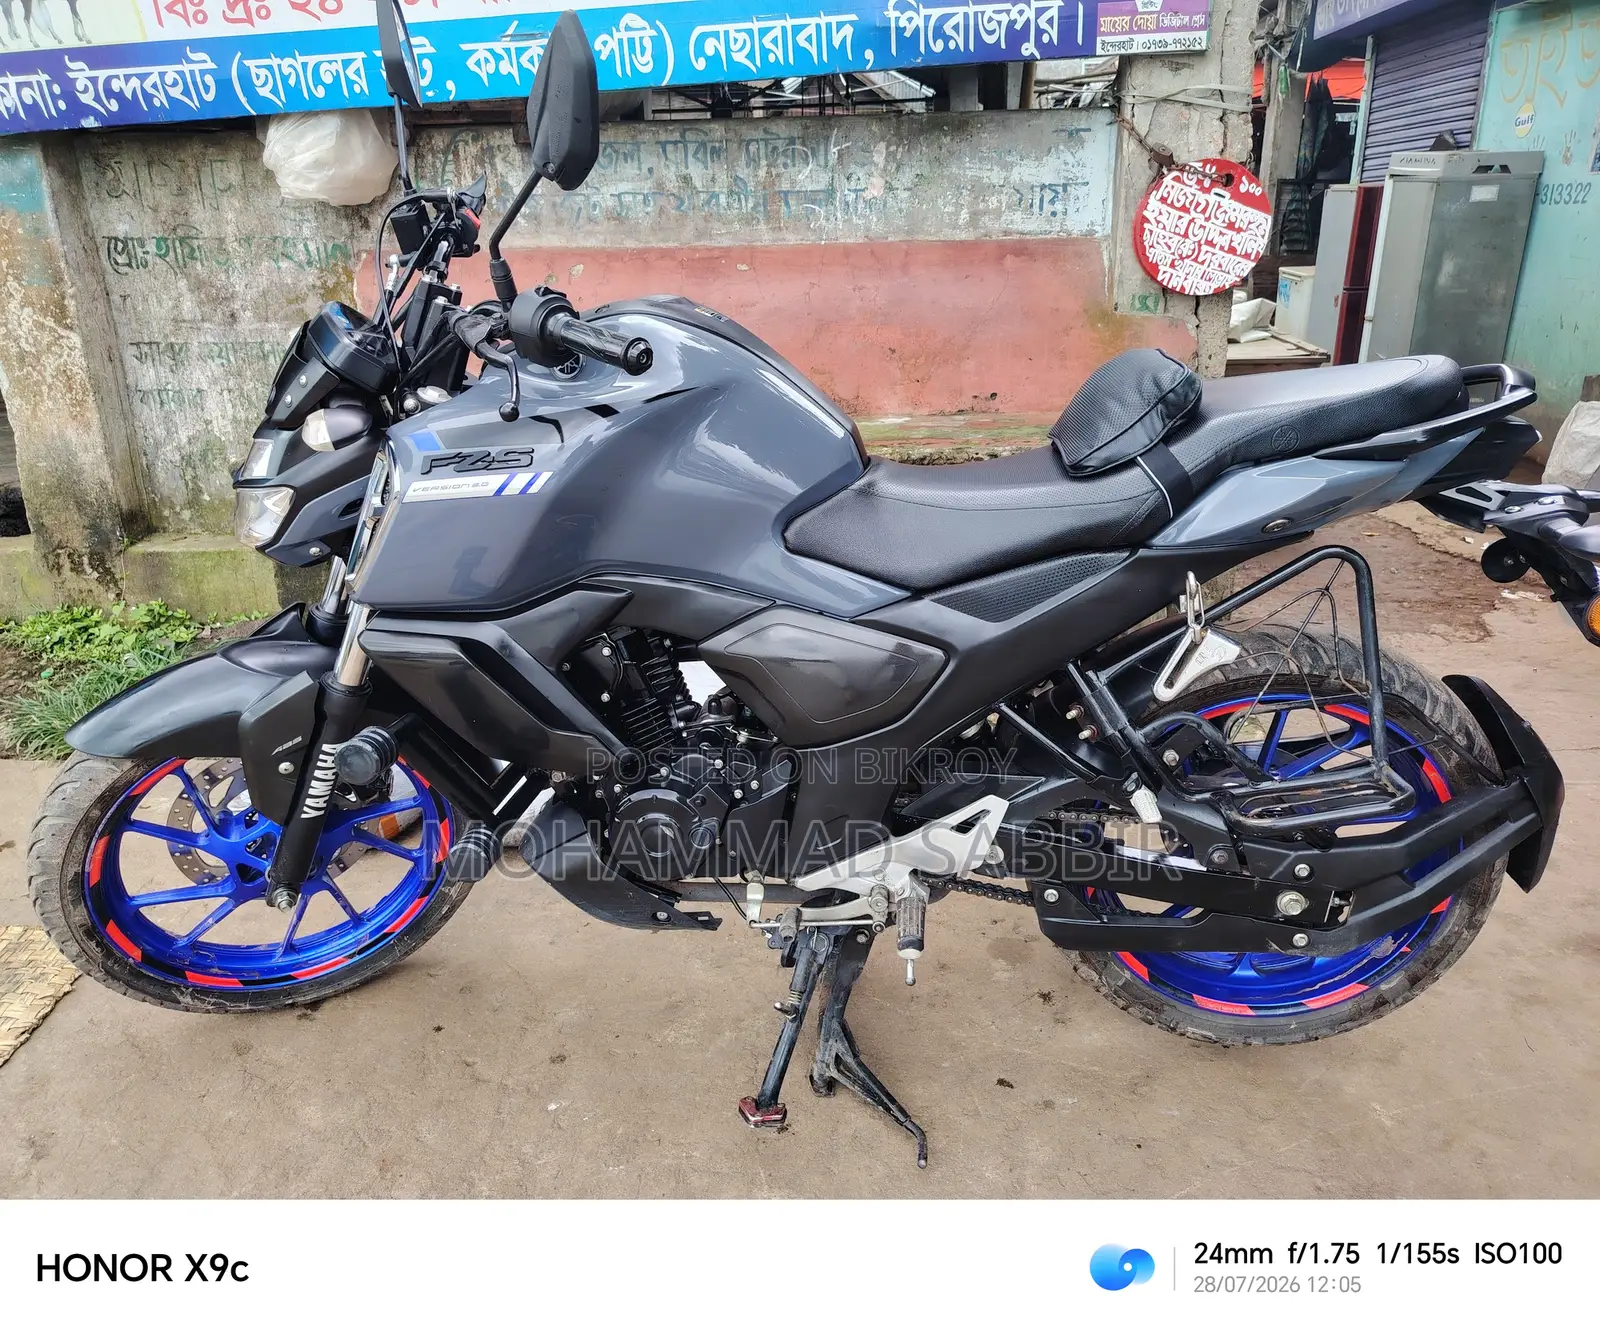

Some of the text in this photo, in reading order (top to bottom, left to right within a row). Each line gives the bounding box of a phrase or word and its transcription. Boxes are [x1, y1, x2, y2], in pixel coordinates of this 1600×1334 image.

[1100, 16, 1131, 33] মায়ের
[1133, 13, 1158, 31] দোয়া
[65, 46, 218, 117] ইন্দেরহাট
[231, 48, 370, 116] (ছাগলের
[1515, 114, 1535, 128] Gulf
